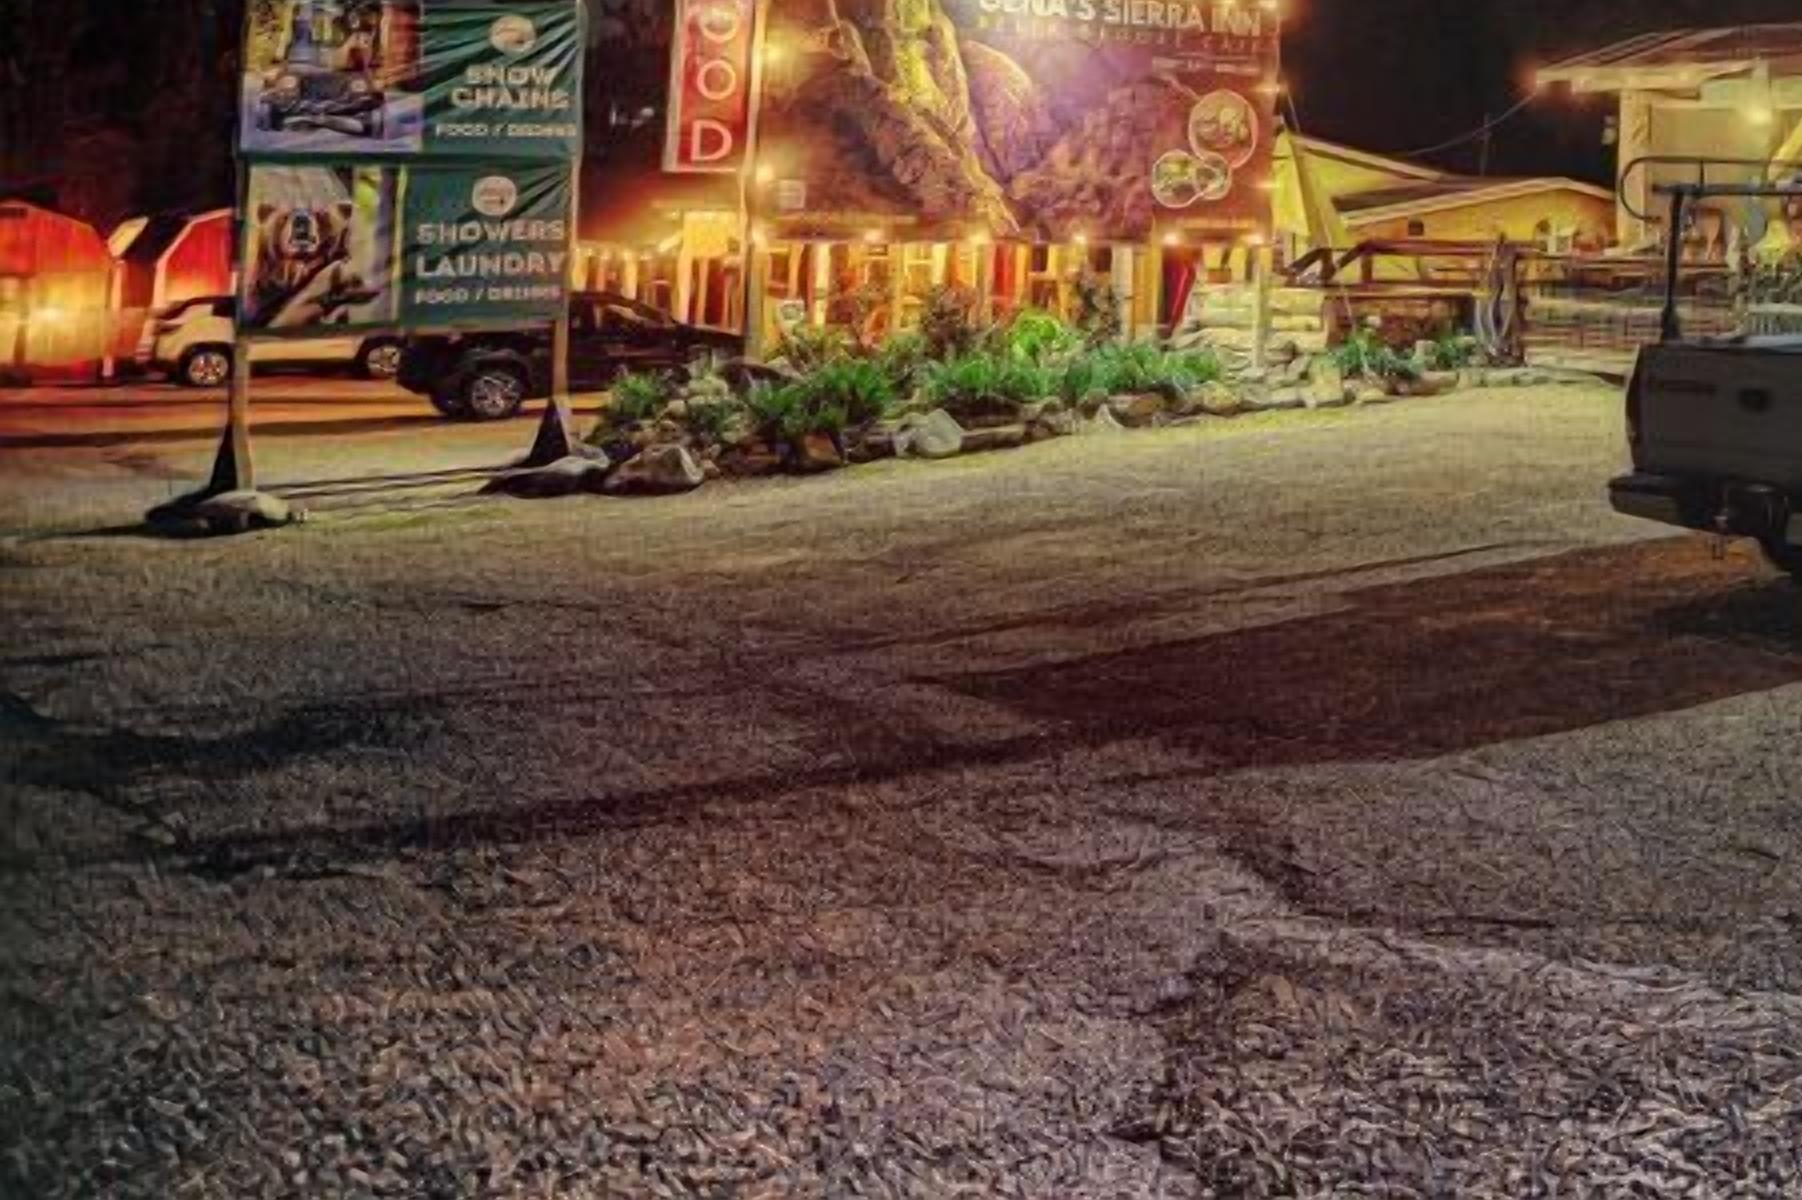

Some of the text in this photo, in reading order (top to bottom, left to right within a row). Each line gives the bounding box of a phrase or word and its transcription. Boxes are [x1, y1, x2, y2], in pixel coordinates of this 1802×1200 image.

[1211, 2, 1261, 37] INN
[466, 64, 561, 87] SNOW
[451, 87, 570, 110] CHAINS
[416, 218, 565, 246] SHOWERS
[415, 251, 564, 278] LAUNDRY
